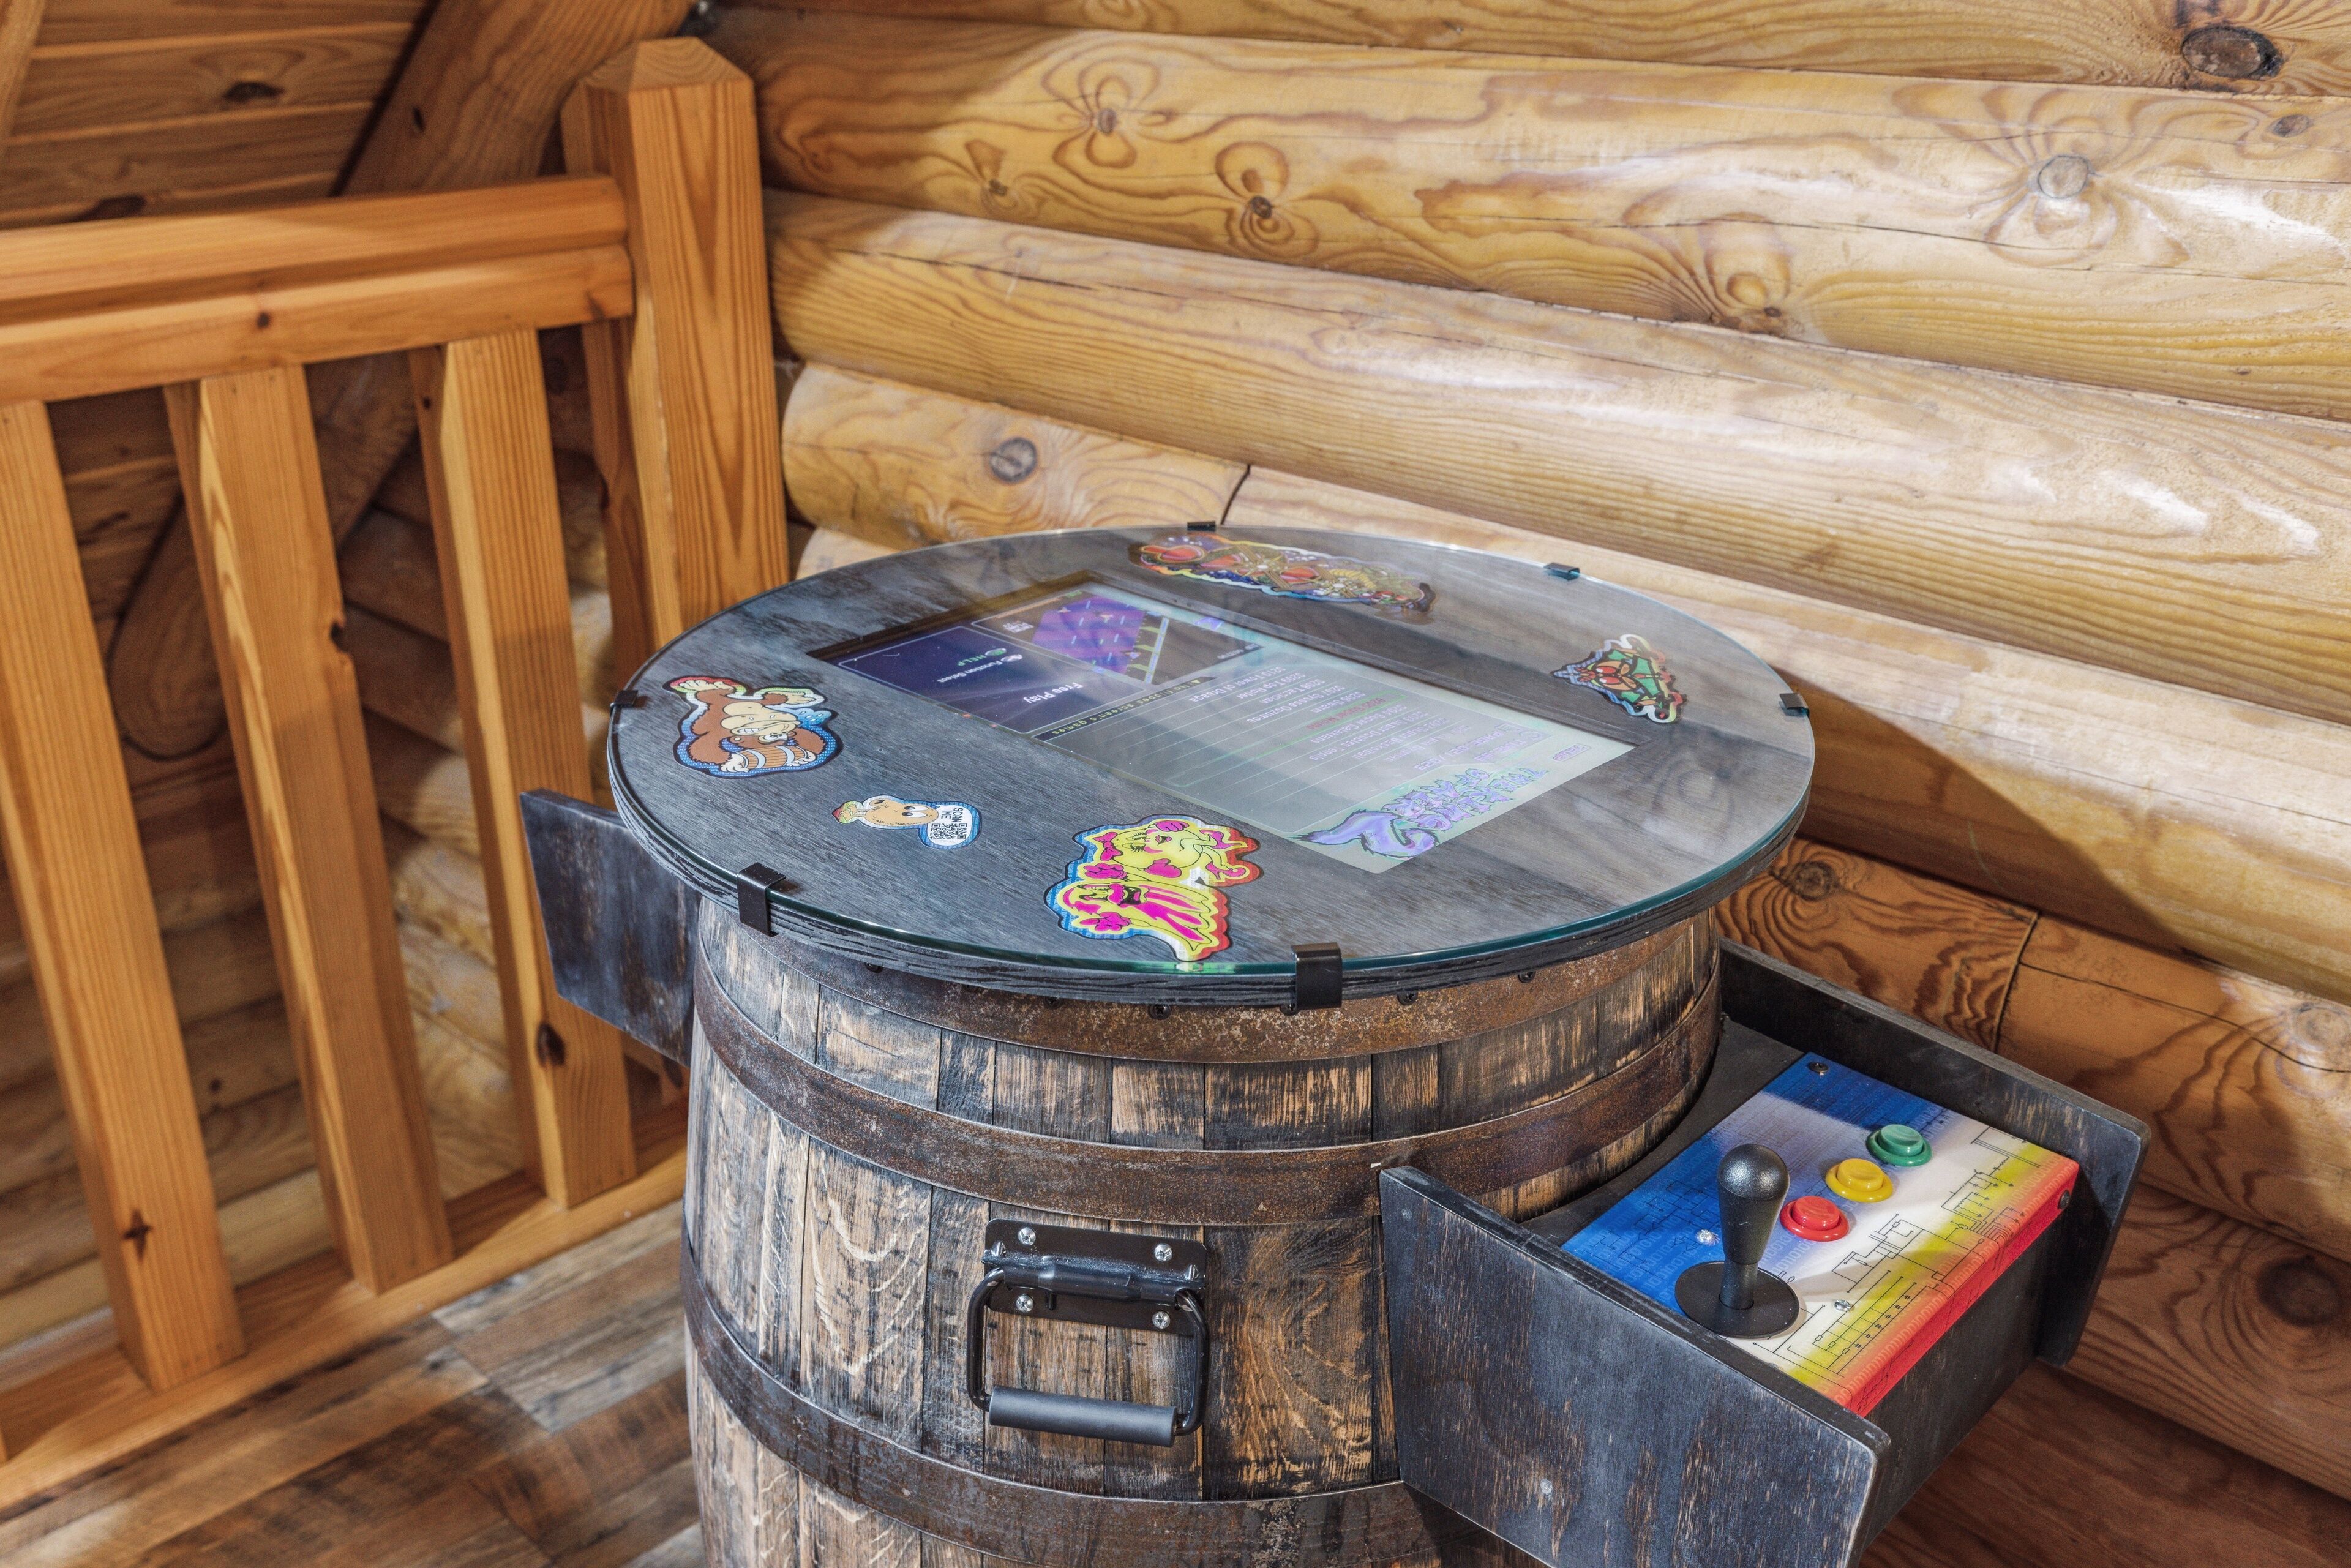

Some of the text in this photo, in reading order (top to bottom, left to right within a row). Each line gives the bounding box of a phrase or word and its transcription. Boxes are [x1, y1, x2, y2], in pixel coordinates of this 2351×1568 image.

[951, 654, 989, 667] HELP
[934, 660, 1005, 683] Function Select
[1232, 674, 1265, 686] Tower
[1259, 680, 1286, 689] Top
[1016, 681, 1086, 705] Free Play
[1187, 688, 1228, 703] Druaga
[1233, 686, 1268, 699] Roller
[1257, 686, 1305, 705] Tactician
[1086, 702, 1137, 722] screen's
[1308, 699, 1346, 714] Swarm
[1048, 719, 1090, 735] games
[1352, 712, 1387, 726] Super
[1374, 719, 1408, 732] Super
[1308, 723, 1361, 745] Galaxians
[1339, 730, 1382, 748] Doubles
[1307, 745, 1346, 761] Tennis
[1349, 737, 1404, 760] Basketball
[1373, 778, 1472, 820] AIR
[951, 808, 964, 823] SCAN
[1408, 786, 1517, 834] KING
